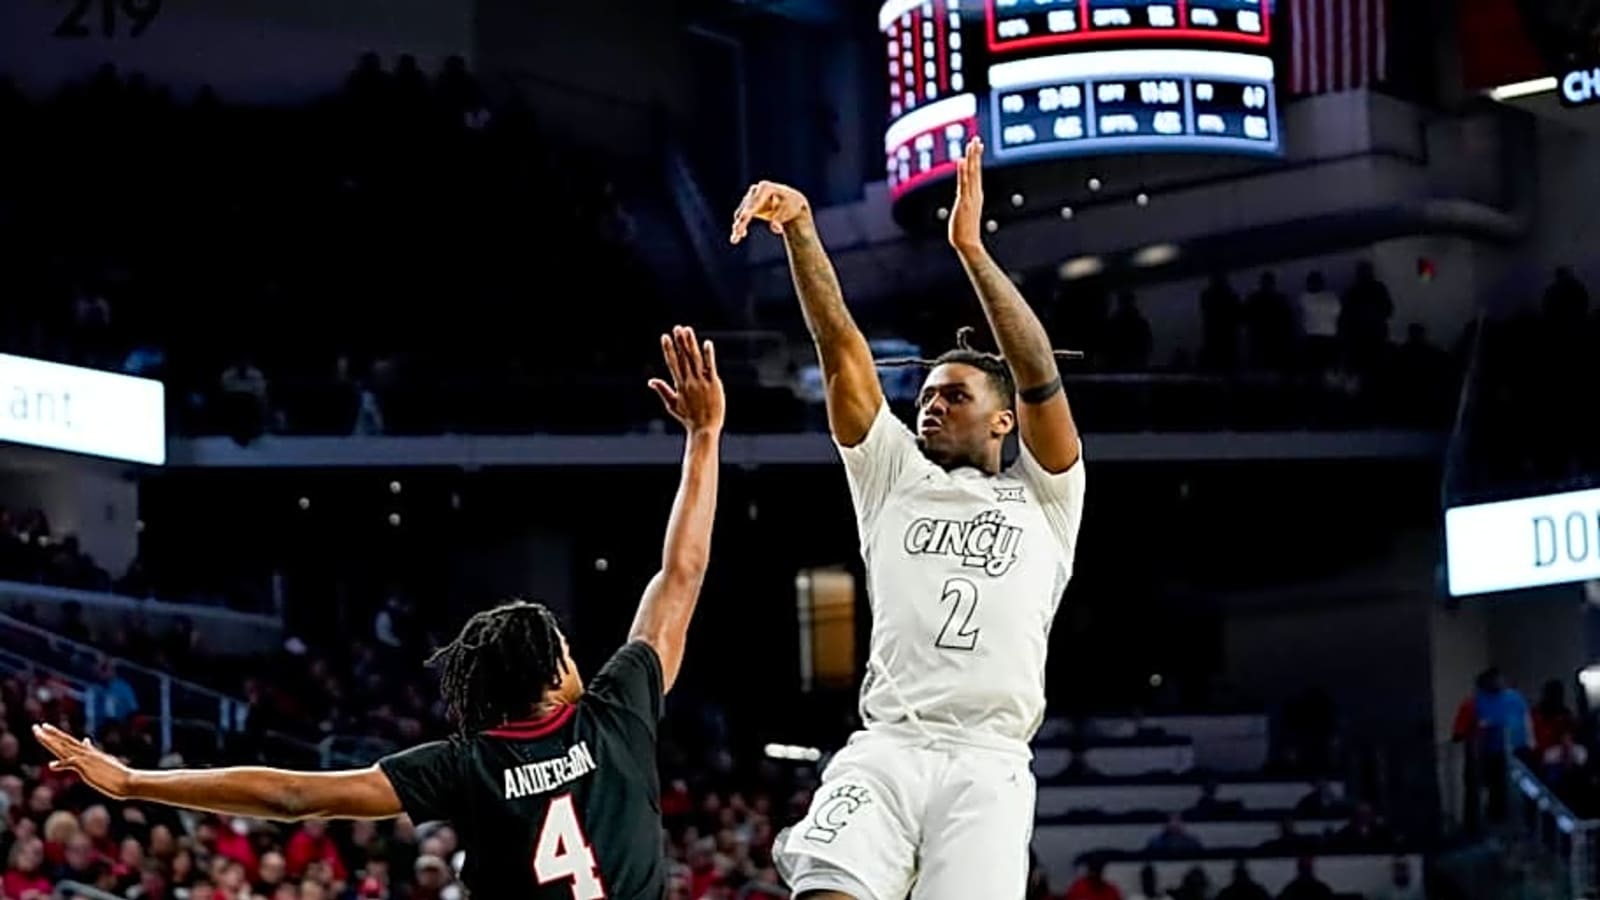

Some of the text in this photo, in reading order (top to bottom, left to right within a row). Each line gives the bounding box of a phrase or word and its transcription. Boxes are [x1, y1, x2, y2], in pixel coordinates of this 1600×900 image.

[51, 0, 162, 38] 219
[904, 512, 1023, 577] CINCY
[1531, 510, 1600, 567] DO
[935, 577, 980, 650] 2
[504, 741, 597, 799] ANDERSON
[533, 791, 605, 900] 4
